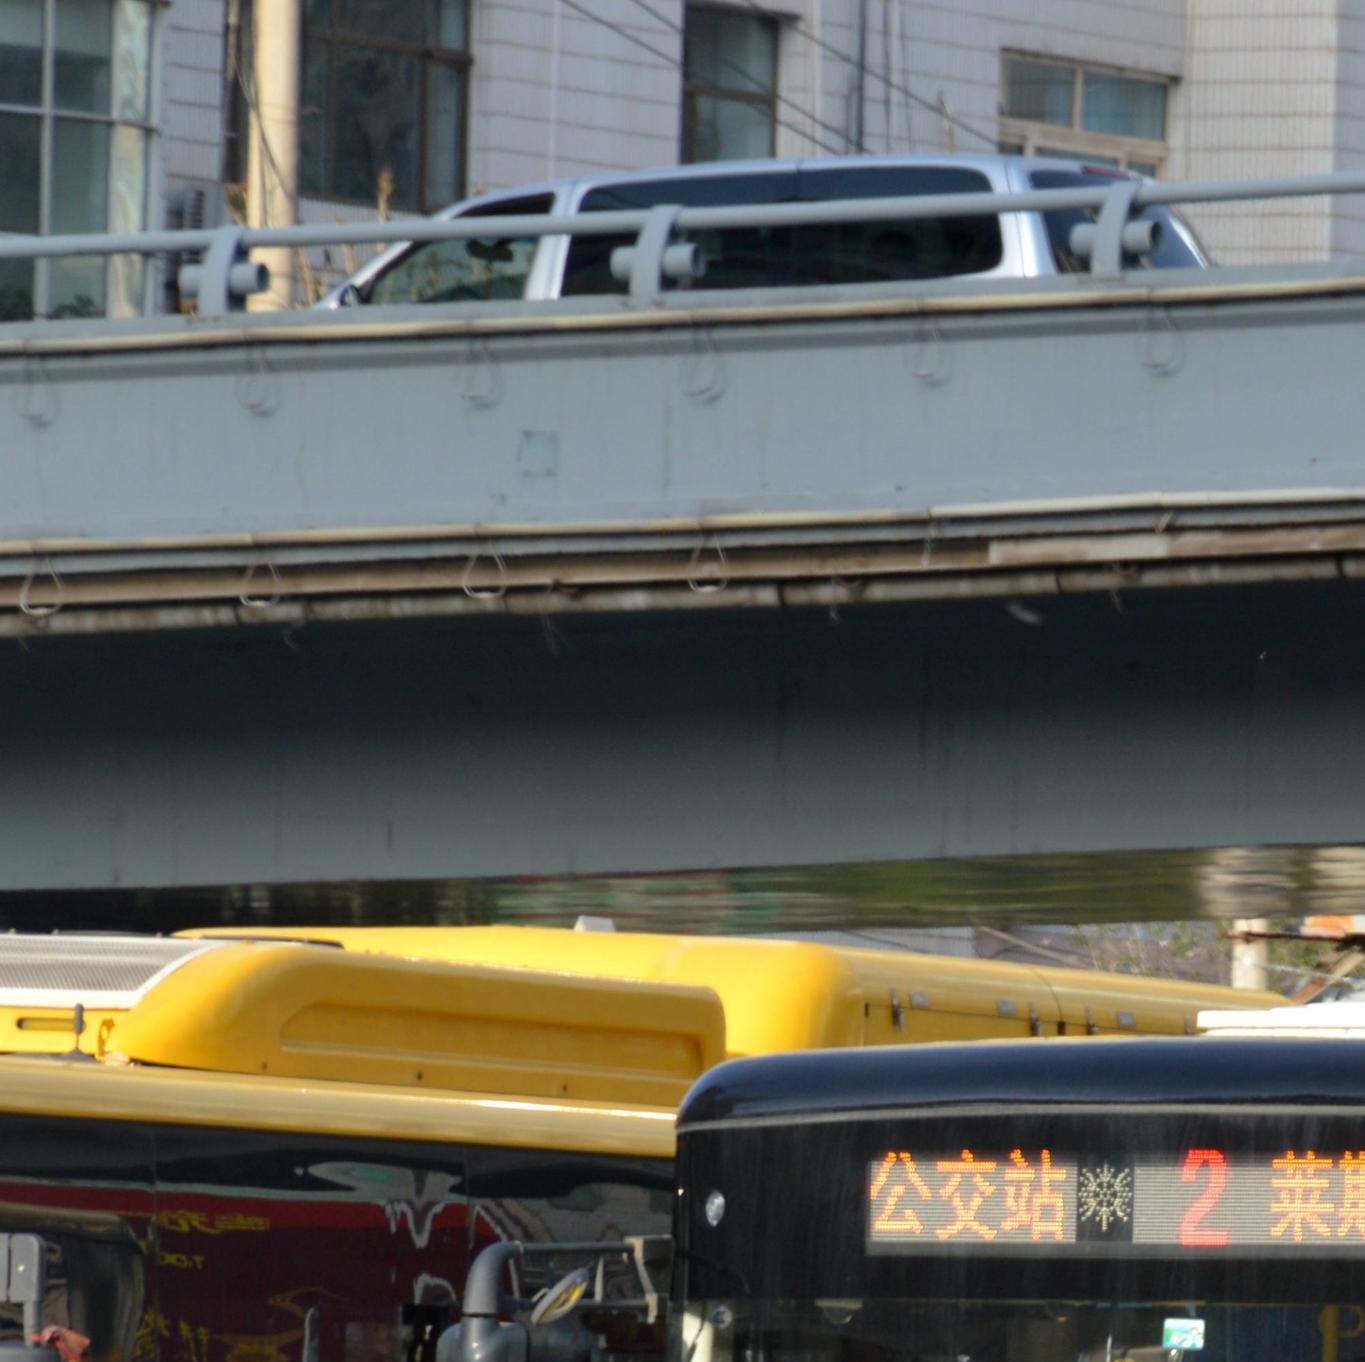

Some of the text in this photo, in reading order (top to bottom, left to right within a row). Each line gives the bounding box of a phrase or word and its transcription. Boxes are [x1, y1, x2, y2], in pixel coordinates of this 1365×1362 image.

[871, 1150, 1067, 1241] 公交站
[1180, 1149, 1229, 1247] 2
